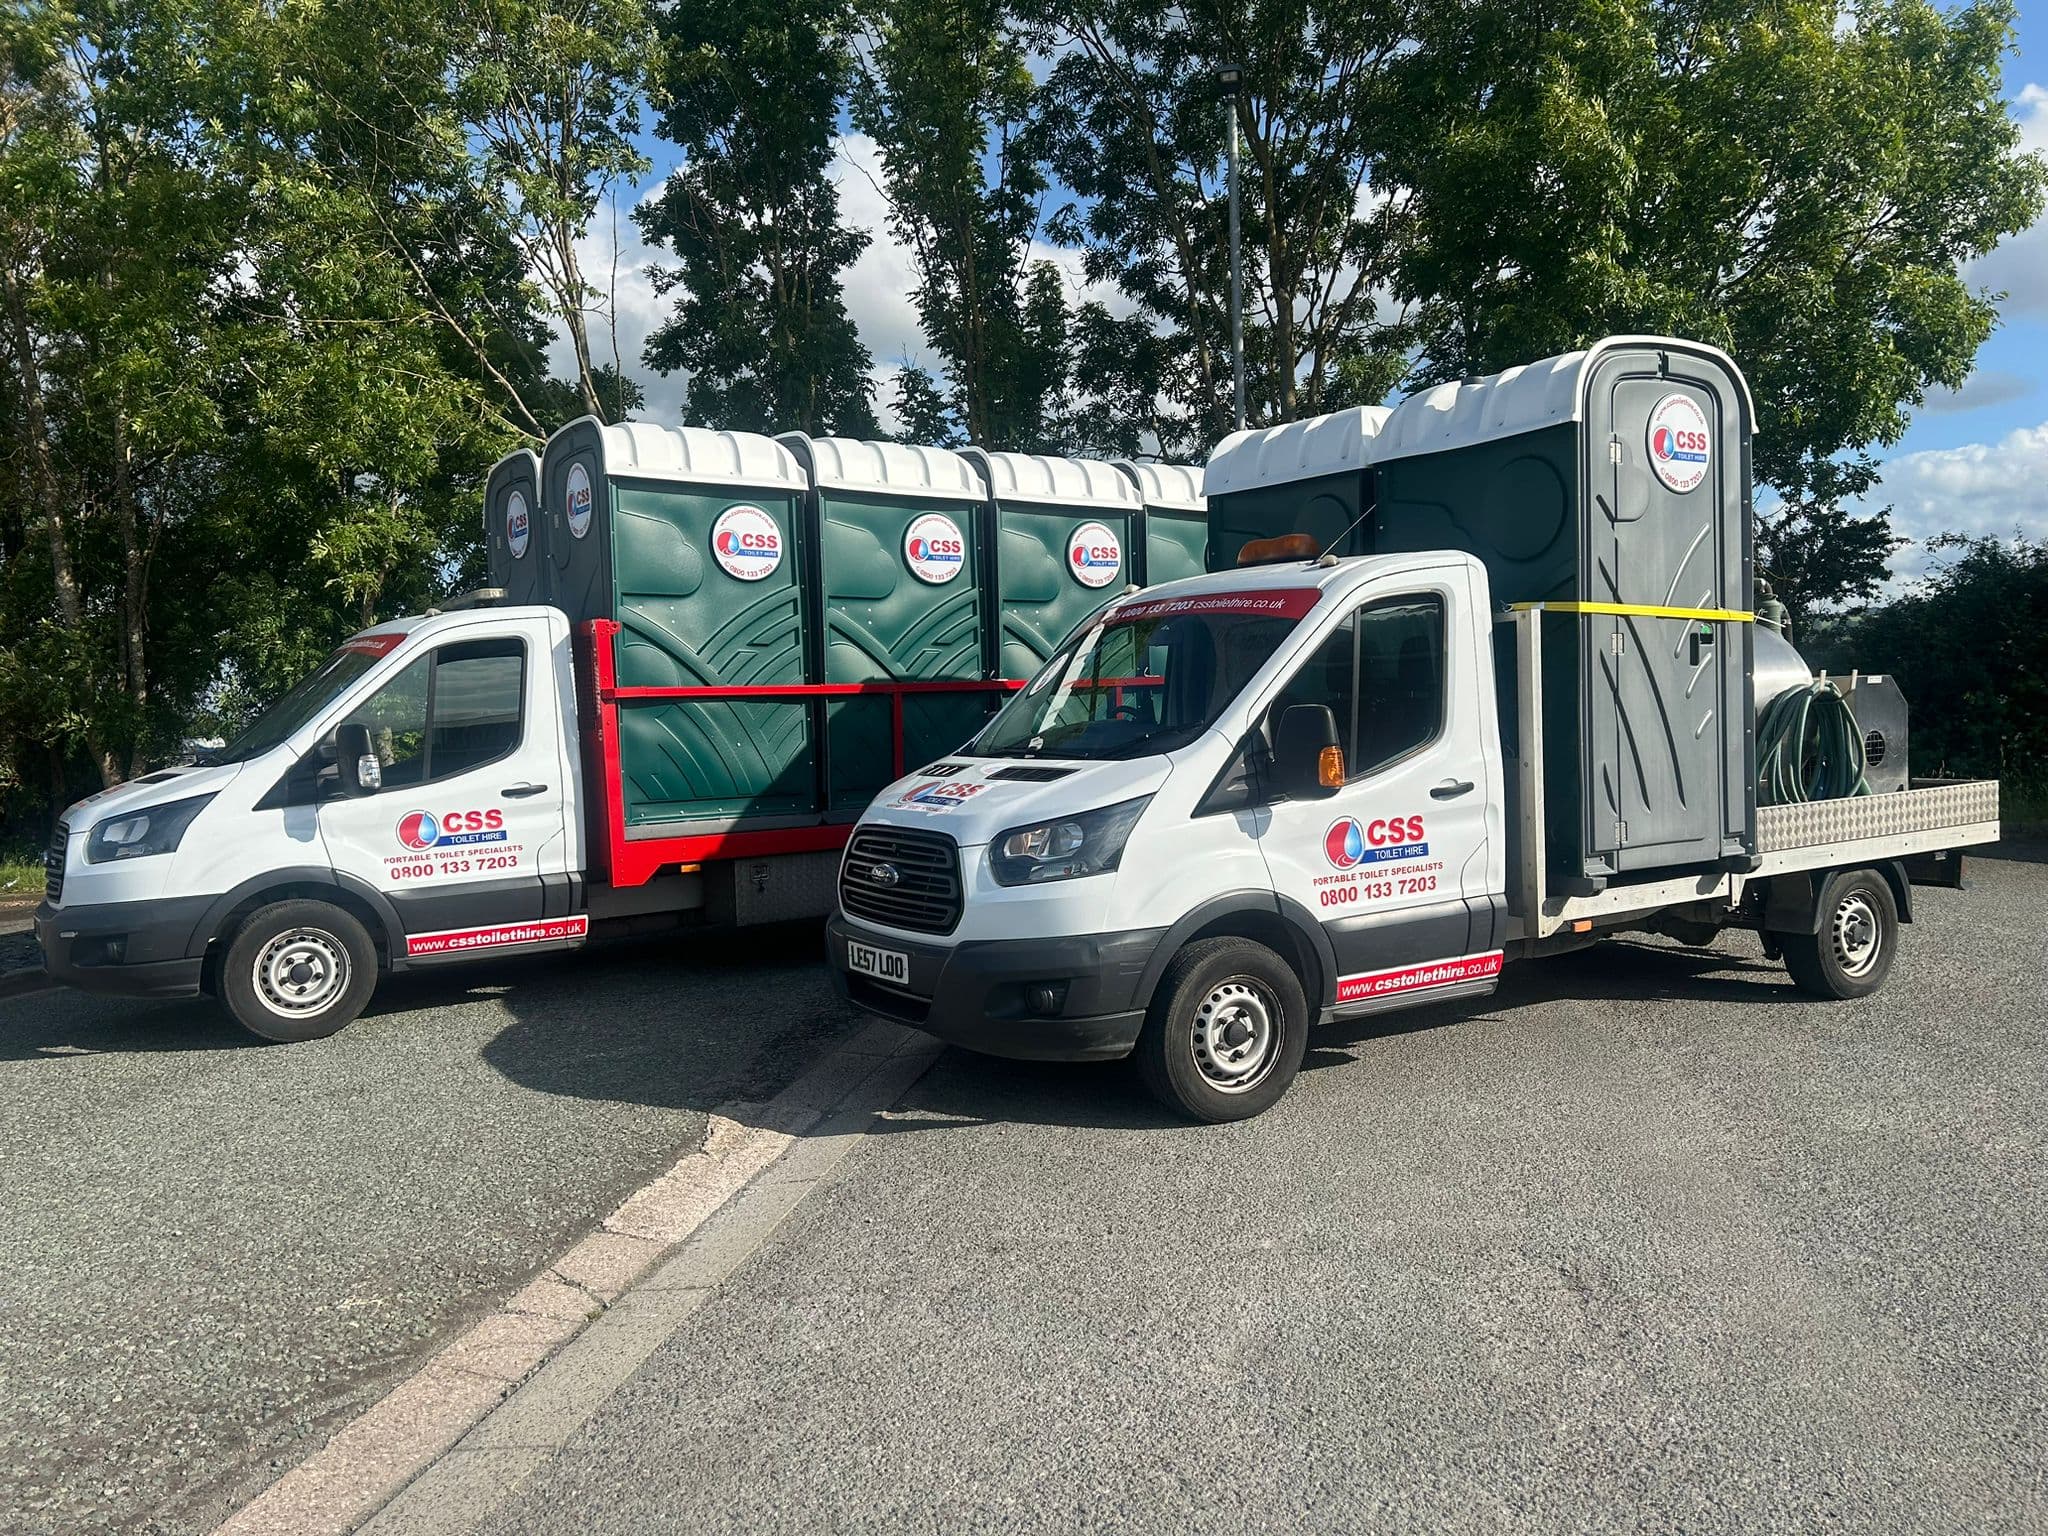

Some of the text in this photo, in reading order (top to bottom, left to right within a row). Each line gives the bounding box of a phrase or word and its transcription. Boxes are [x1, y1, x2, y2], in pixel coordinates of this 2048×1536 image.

[1677, 431, 1706, 450] CSS
[577, 488, 589, 505] CSS
[516, 513, 527, 528] CSS
[742, 534, 777, 548] CSS
[931, 540, 960, 553] CSS
[1092, 547, 1117, 559] CSS
[730, 565, 745, 576] 0800
[760, 564, 773, 574] 7203
[1165, 600, 1194, 612] 7203
[1193, 598, 1285, 608] csstoilethire.co.uk
[935, 783, 985, 797] CSS
[443, 809, 503, 833] CSS
[450, 832, 502, 844] TOILET HIRE
[1367, 815, 1424, 846] CSS
[384, 845, 523, 864] PORTABLE TOILET SPECIALISTS
[1375, 845, 1424, 860] TOILET HIRE
[391, 855, 518, 880] 0800 133 7203
[1313, 862, 1443, 886] PORTABLE TOILET SPECIALISTS
[1320, 876, 1437, 906] 0800 133 7203
[412, 923, 582, 952] www.csstoilethire.co.uk
[851, 945, 903, 978] LE57 LOO
[1342, 959, 1497, 997] www.csstoilethire.co.uk
